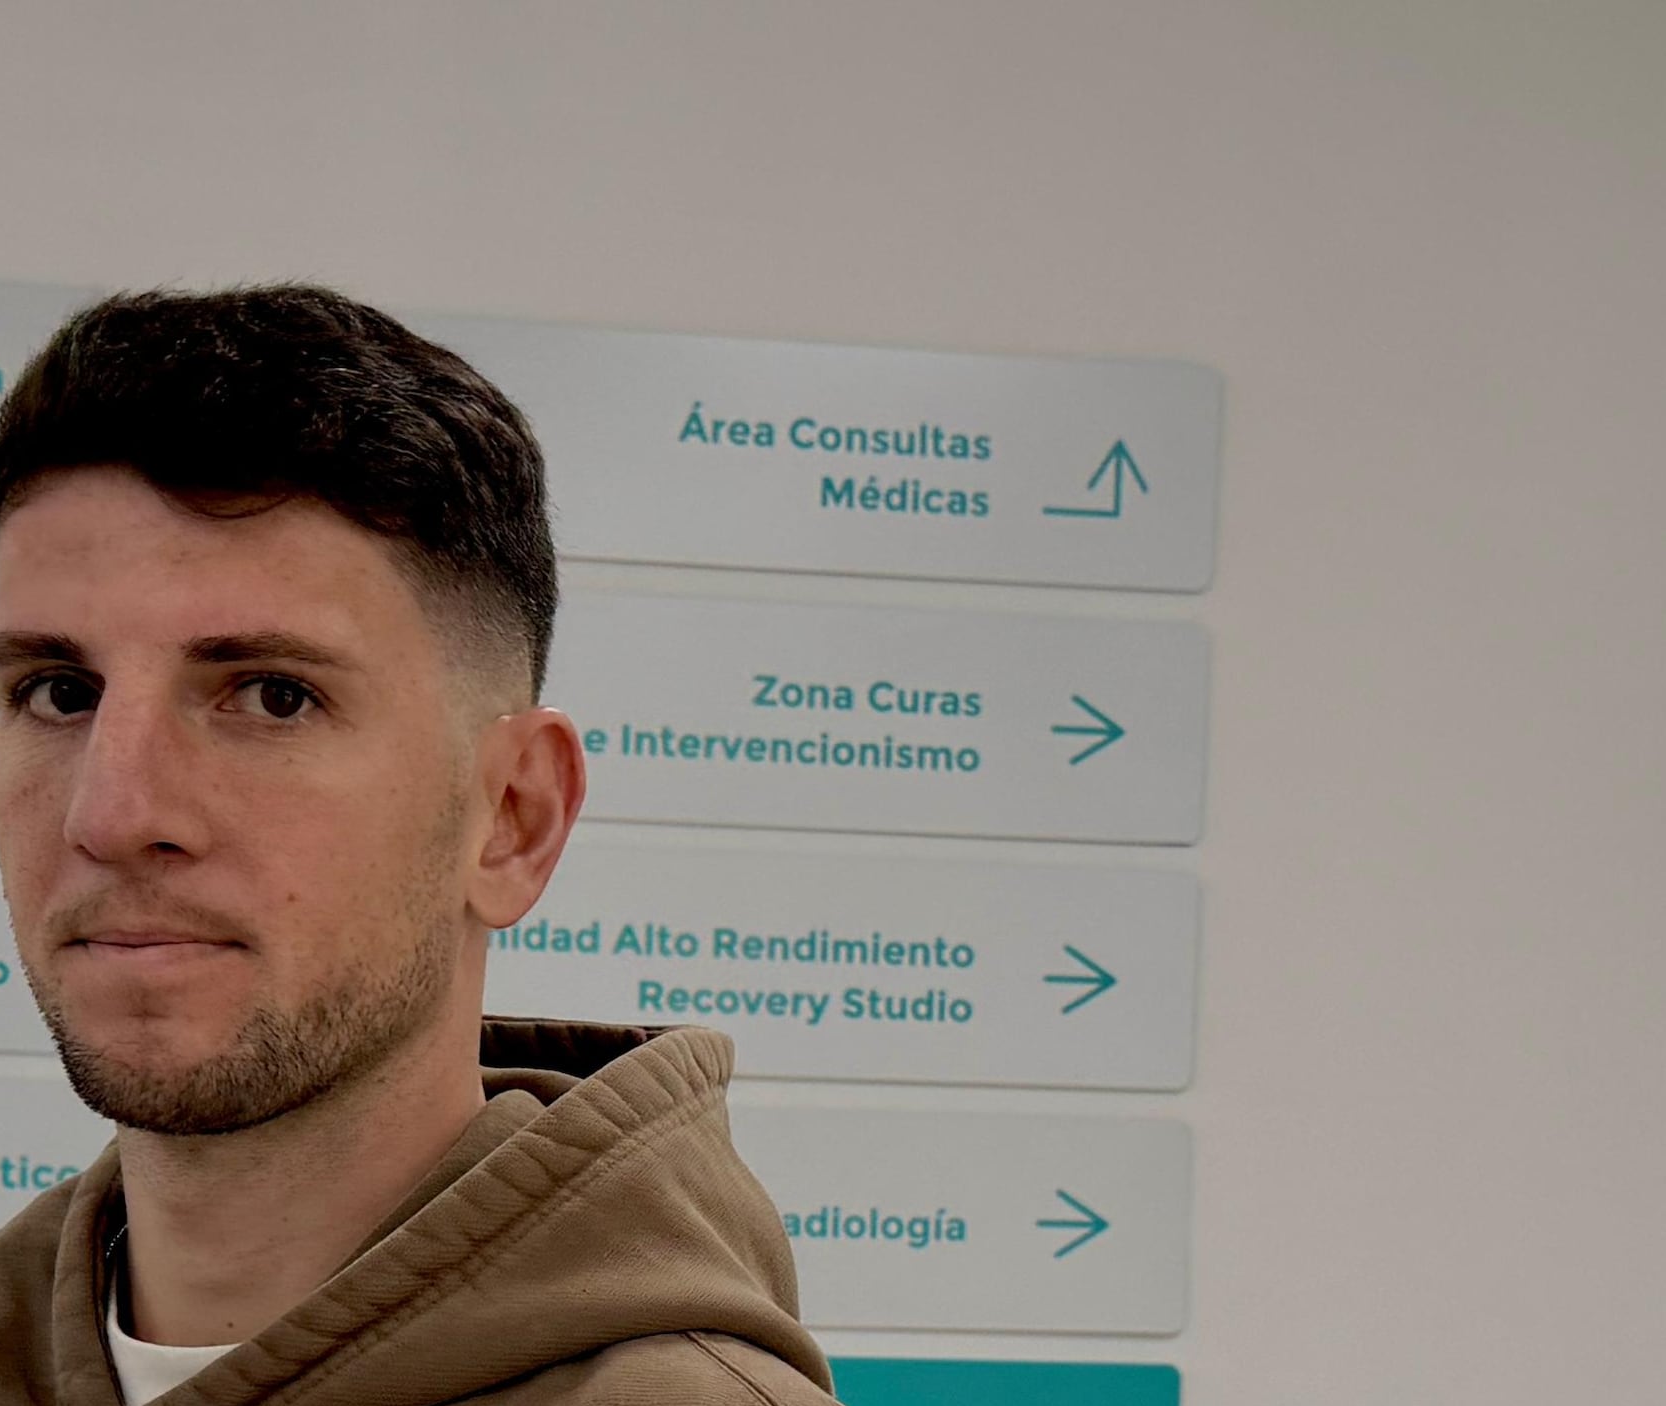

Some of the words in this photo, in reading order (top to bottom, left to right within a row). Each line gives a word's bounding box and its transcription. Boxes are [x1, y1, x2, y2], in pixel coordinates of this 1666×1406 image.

[679, 400, 778, 449] Área
[787, 417, 992, 462] Consultas
[819, 473, 991, 520] Médicas
[752, 674, 857, 712] Zona
[867, 681, 984, 719] Curas
[583, 729, 609, 755] e
[621, 724, 984, 774] Intervencionismo
[487, 918, 603, 955] nidad
[614, 923, 702, 961] Alto
[712, 927, 978, 970] Rendimiento
[637, 979, 832, 1028] Recovery
[842, 987, 975, 1025] Studio
[783, 1205, 969, 1252] adiología
